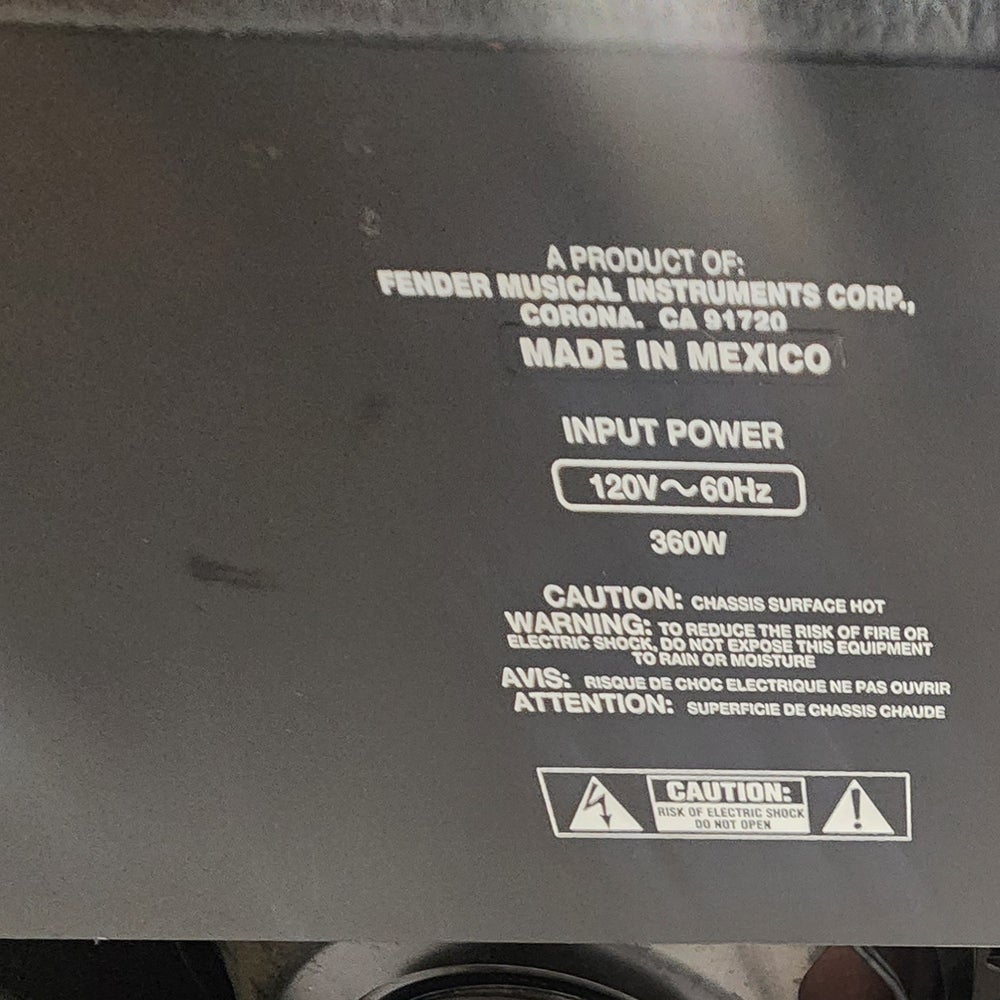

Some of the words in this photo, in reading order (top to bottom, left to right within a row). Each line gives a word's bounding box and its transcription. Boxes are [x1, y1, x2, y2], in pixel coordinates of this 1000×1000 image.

[547, 244, 567, 270] A
[569, 245, 696, 275] PRODUCT
[701, 249, 745, 276] OF:
[377, 270, 493, 298] FENDER
[496, 272, 622, 302] MUSICAL
[627, 277, 822, 309] INSTRUMENTS
[826, 283, 915, 316] CORP.,
[659, 306, 698, 330] CA
[703, 308, 788, 332] 91720
[519, 337, 628, 369] MADE
[636, 339, 678, 371] IN
[686, 340, 831, 375] MEXICO
[561, 416, 660, 446] INPUT
[665, 418, 785, 450] POWER
[649, 529, 727, 556] 360W
[543, 583, 684, 610] CAUTION:
[690, 595, 766, 612] CHASSIS
[768, 597, 848, 614] SURFACE
[850, 599, 886, 614] HOT
[504, 611, 653, 636] WARNING:
[657, 621, 683, 636] TO
[685, 622, 756, 638] REDUCE
[758, 623, 792, 639] THE
[794, 624, 834, 639] RISK
[837, 625, 861, 640] OF
[864, 625, 901, 640] FIRE
[903, 626, 929, 641] OR
[506, 634, 591, 650] ELECTRIC
[592, 635, 658, 652] SHOCK,
[659, 636, 688, 651] DO
[689, 637, 725, 652] NOT
[728, 638, 794, 653] EXPOSE
[796, 639, 834, 655] THIS
[836, 640, 934, 656] EQUIPMENT
[631, 651, 657, 665] TO
[659, 652, 699, 666] RAIN
[702, 652, 728, 667] OR
[730, 653, 816, 669] MOISTURE
[501, 666, 572, 690] AVIS:
[583, 675, 647, 690] RISQUE
[649, 676, 673, 691] DE
[674, 677, 724, 692] CHOC
[726, 678, 828, 693] ELECTRIQUE
[830, 679, 853, 694] NE
[855, 680, 888, 694] PAS
[890, 680, 951, 695] OUVRIR
[514, 691, 674, 714] ATTENTION:
[687, 700, 780, 716] SUPERFICIE
[783, 702, 807, 717] DE
[808, 703, 877, 718] CHASSIS
[879, 704, 945, 719] CHAUDE
[666, 780, 793, 803] CAUTION:
[658, 807, 685, 818] RISK
[688, 807, 703, 818] OF
[707, 807, 762, 818] ELECTRIC
[766, 808, 805, 819] SHOCK
[695, 819, 711, 829] DO
[714, 820, 737, 829] NOT
[741, 820, 772, 830] OPEN
